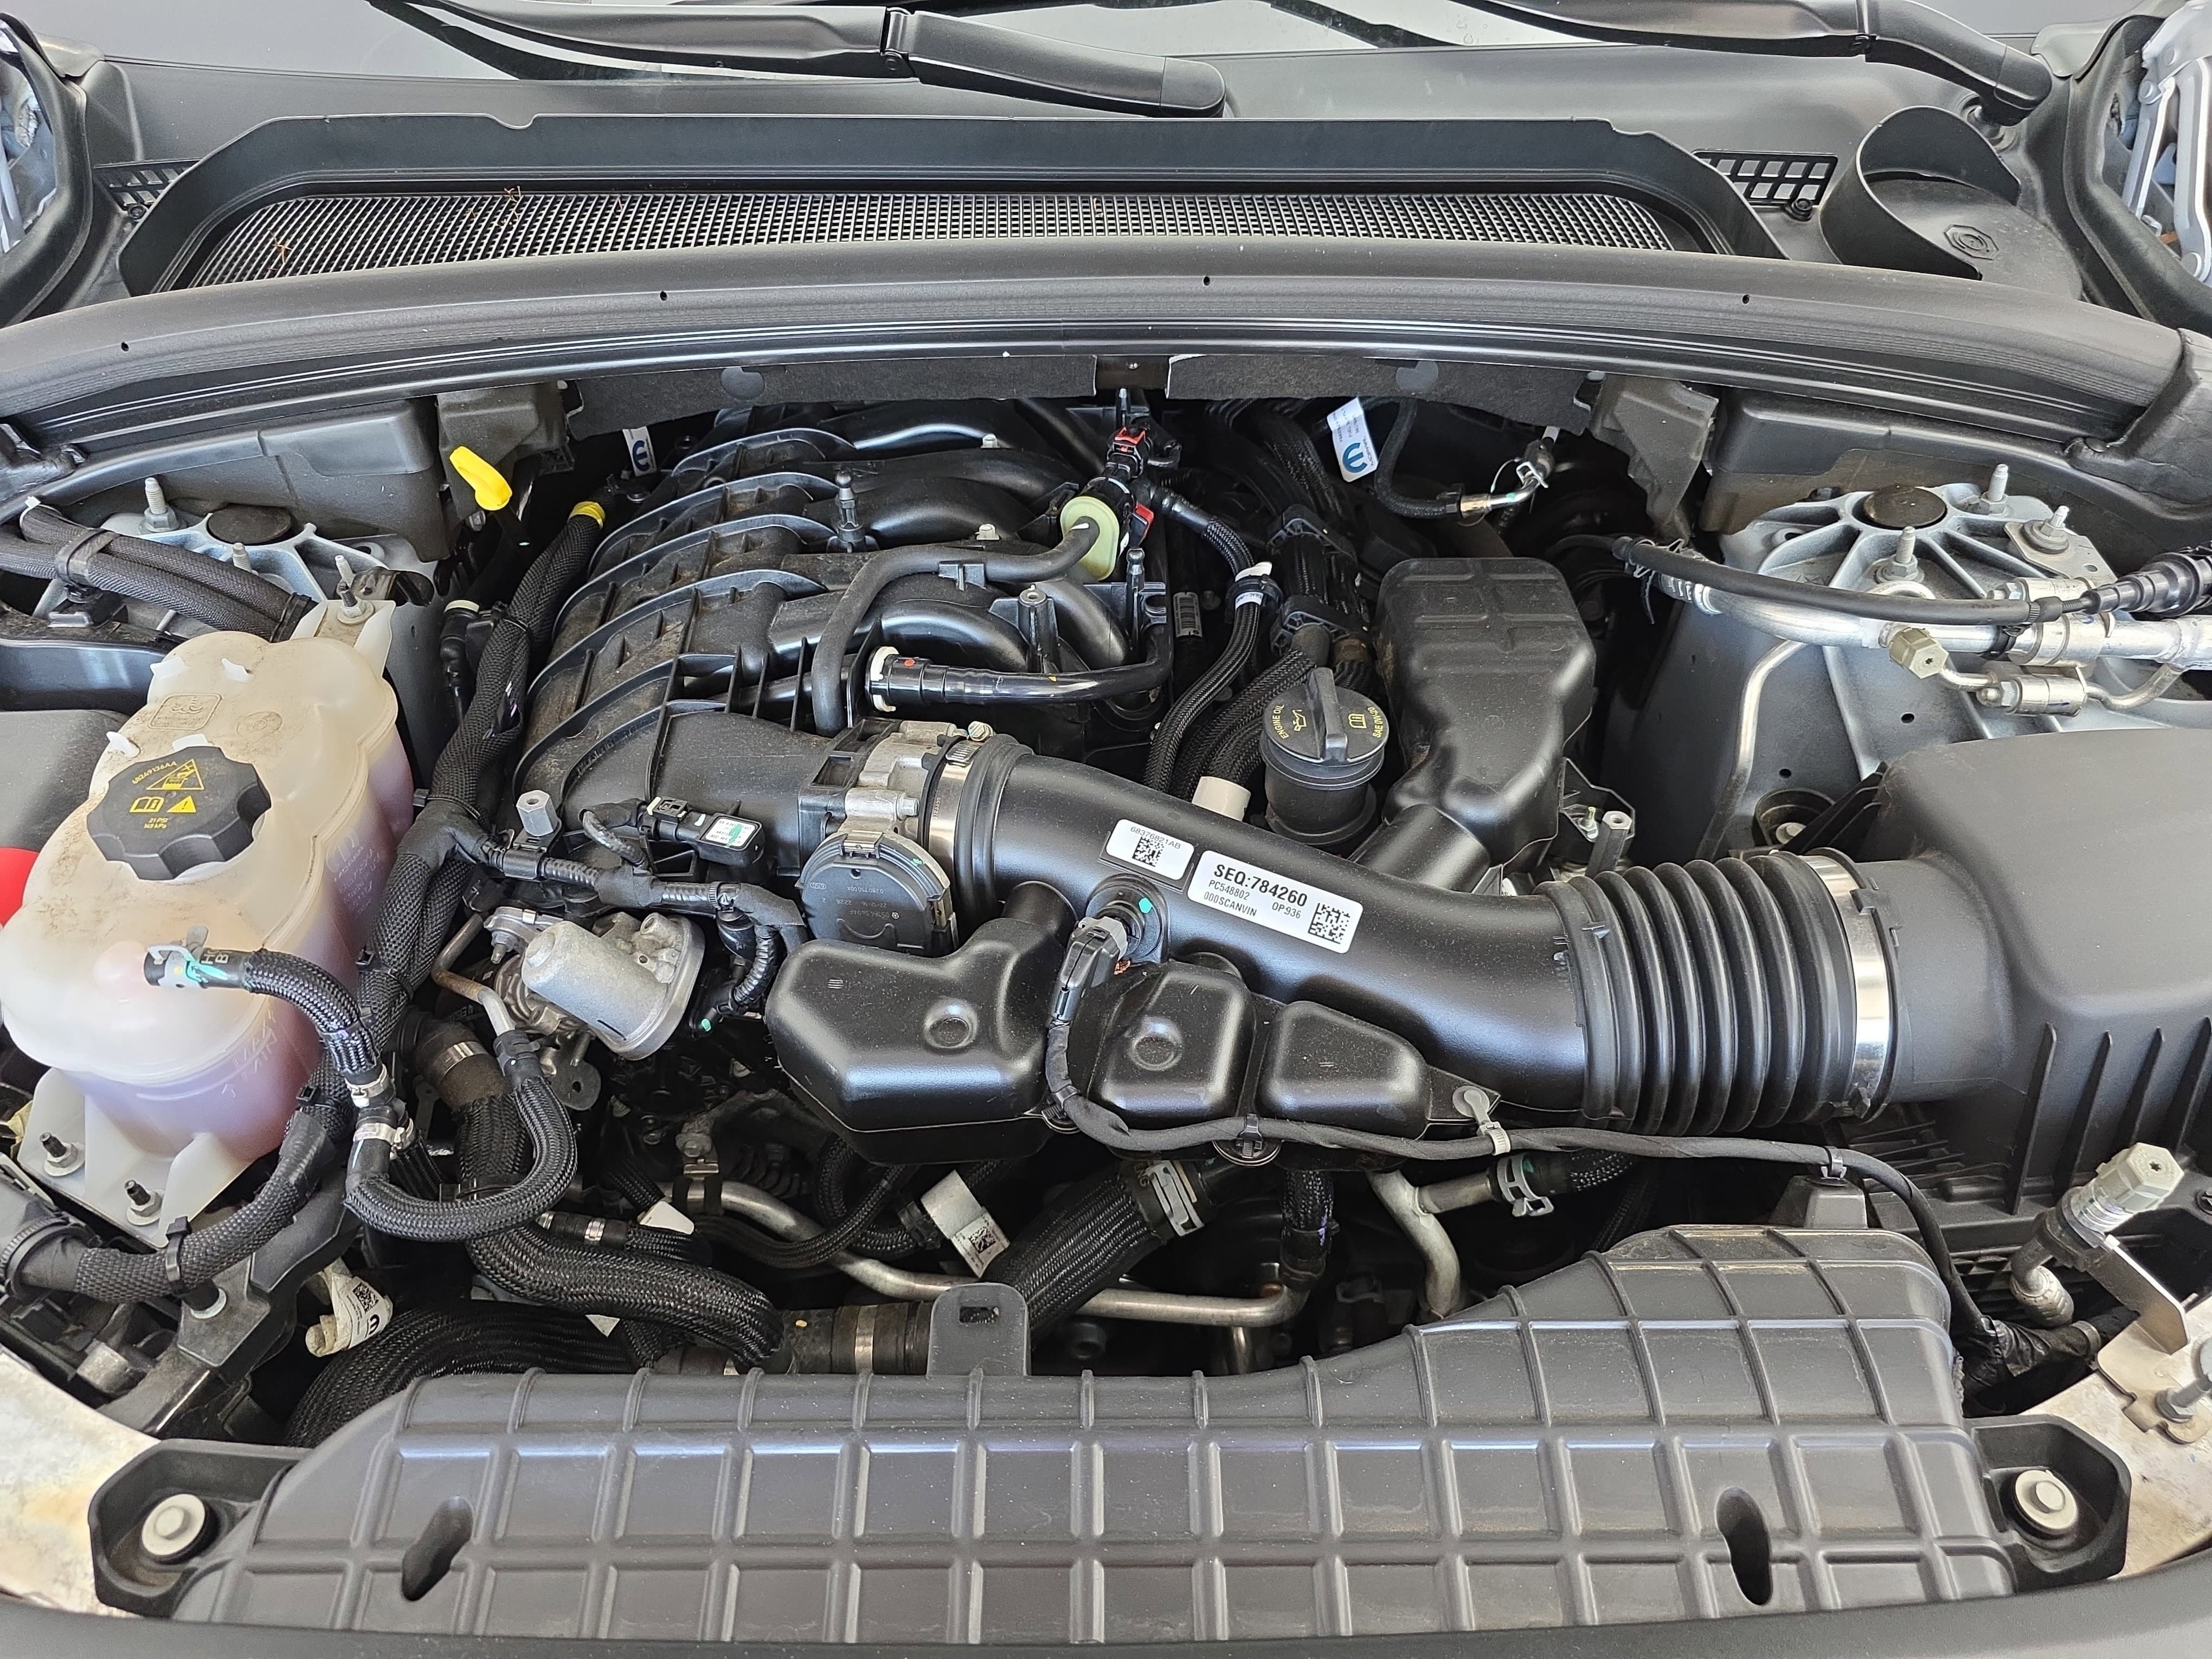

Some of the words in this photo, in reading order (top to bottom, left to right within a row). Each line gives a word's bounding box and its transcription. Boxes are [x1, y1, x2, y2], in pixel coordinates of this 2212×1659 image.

[1274, 704, 1284, 715] OIL
[1367, 706, 1382, 725] 0W-20
[1272, 715, 1289, 740] ENGINE
[1372, 725, 1383, 738] SAE
[1130, 826, 1181, 849] 68376821AB
[1213, 864, 1308, 907] SEQ:784260
[1203, 891, 1257, 917] 000SCANVIN
[1208, 879, 1250, 901] PC548802
[1272, 902, 1301, 919] OP:936
